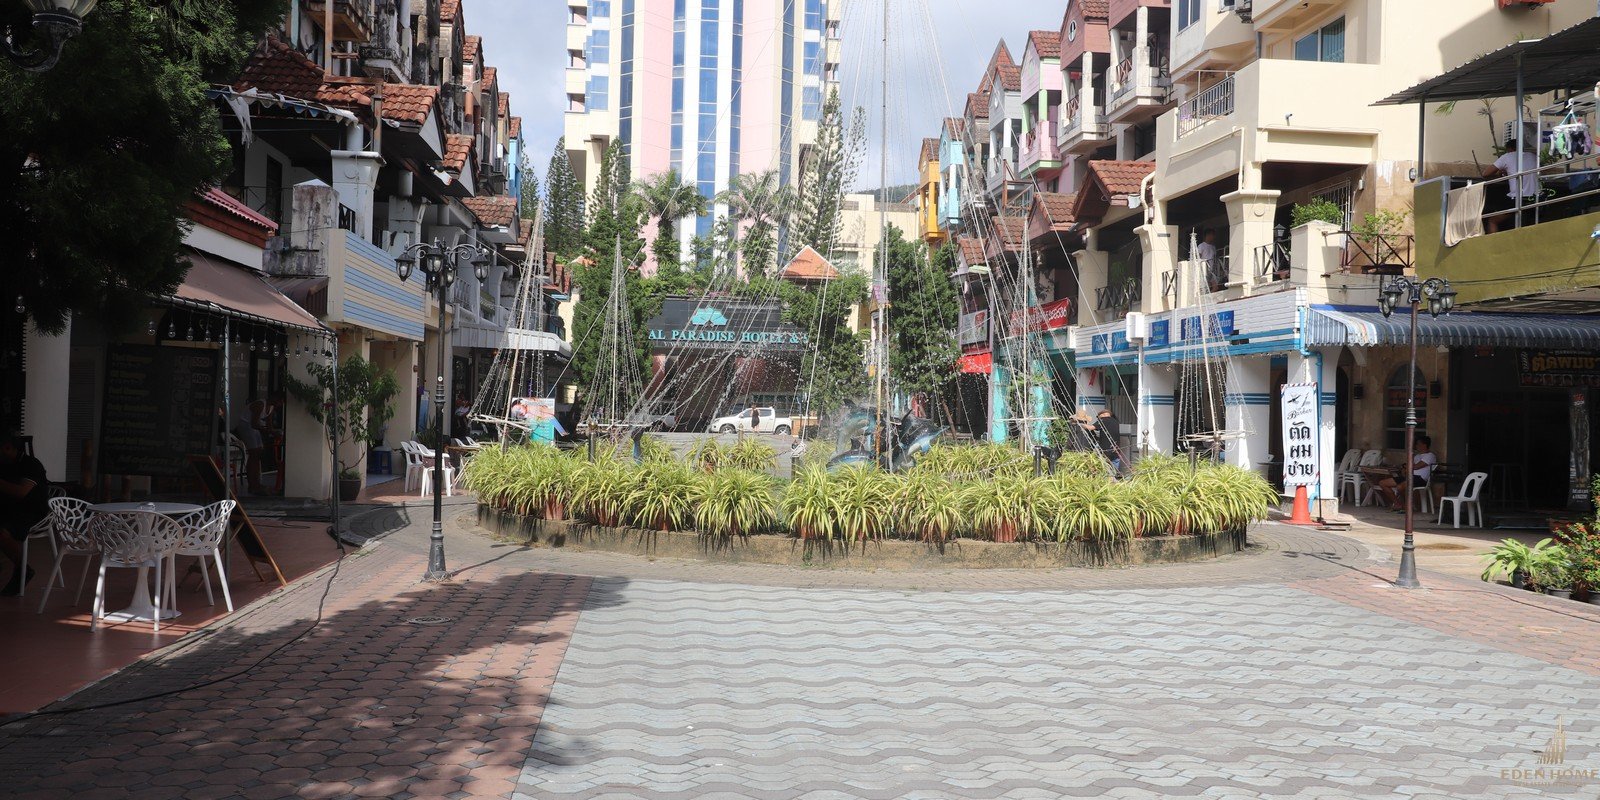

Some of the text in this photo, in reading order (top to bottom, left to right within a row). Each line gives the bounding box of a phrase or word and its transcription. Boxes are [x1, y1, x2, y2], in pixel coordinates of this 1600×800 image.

[672, 329, 735, 342] PARADISE
[741, 331, 785, 344] HOTEL
[1289, 420, 1311, 440] ตัด
[1289, 444, 1312, 459] ผม
